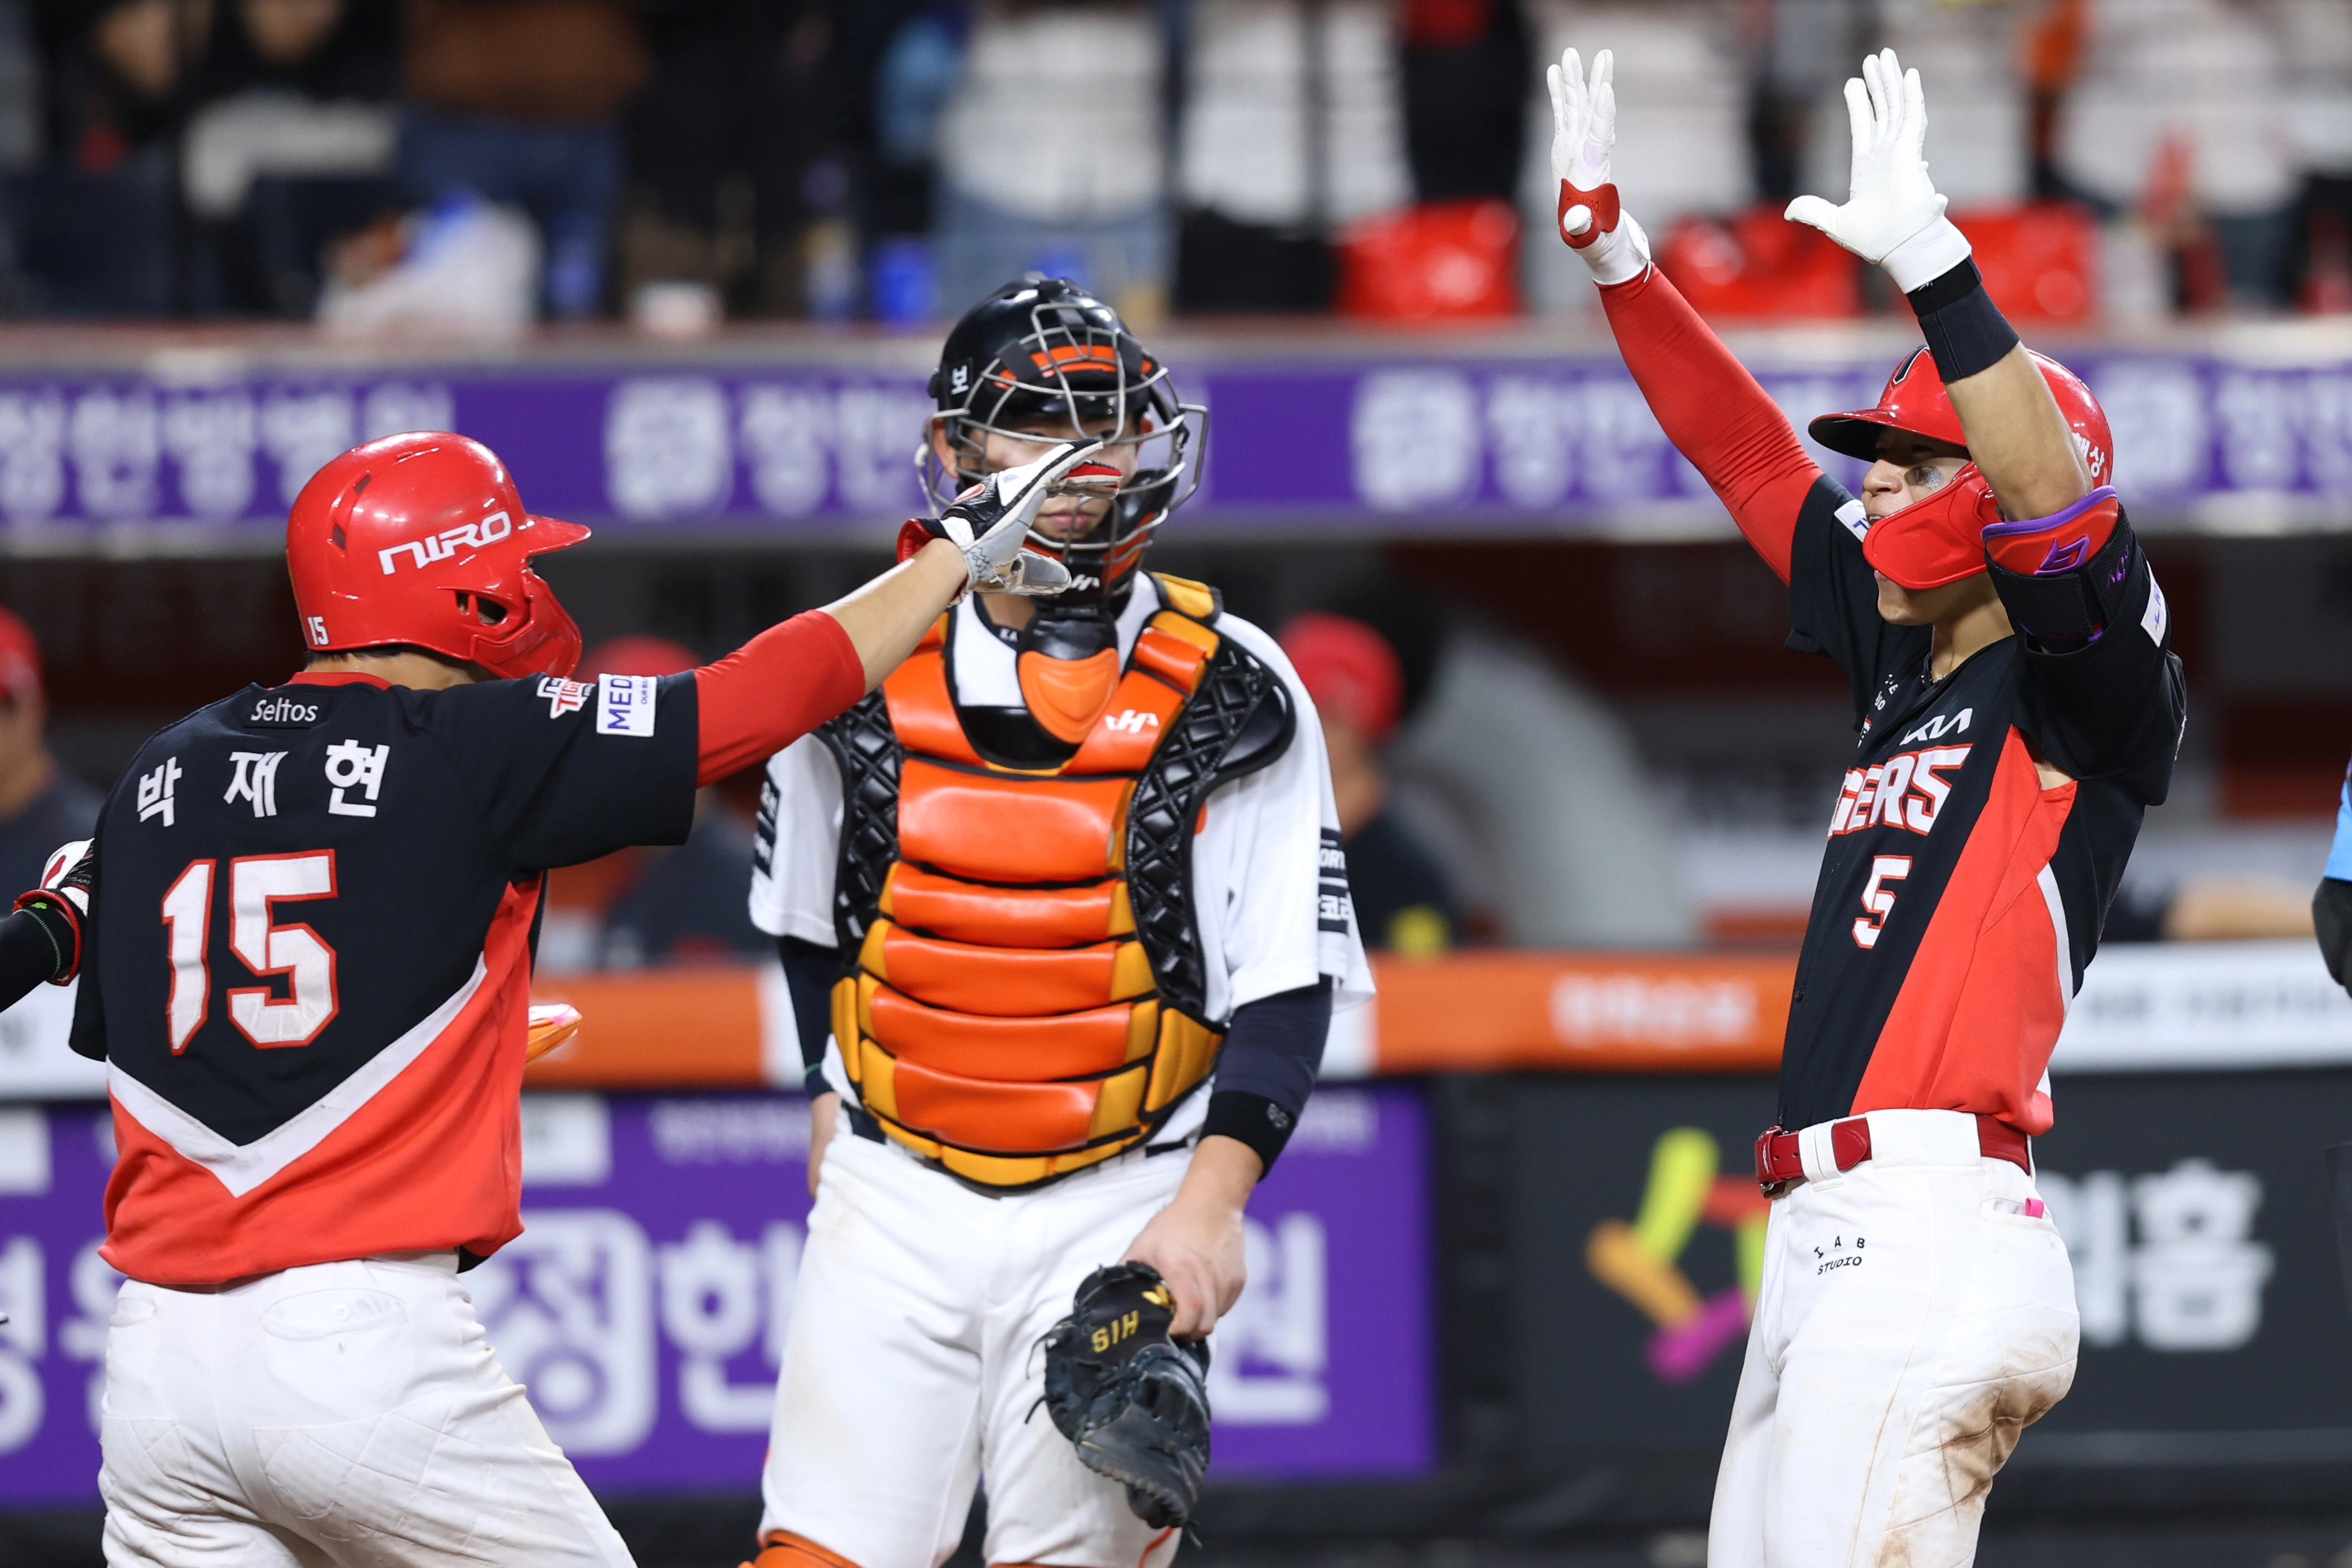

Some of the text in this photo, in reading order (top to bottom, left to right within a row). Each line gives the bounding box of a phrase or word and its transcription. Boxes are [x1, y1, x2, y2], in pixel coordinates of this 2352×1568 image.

[377, 510, 512, 575] NIRO
[306, 616, 329, 646] 15
[251, 697, 319, 724] Seltos
[1851, 855, 1913, 949] 5
[160, 848, 340, 1056] 15
[1817, 1256, 1862, 1276] STUDIO
